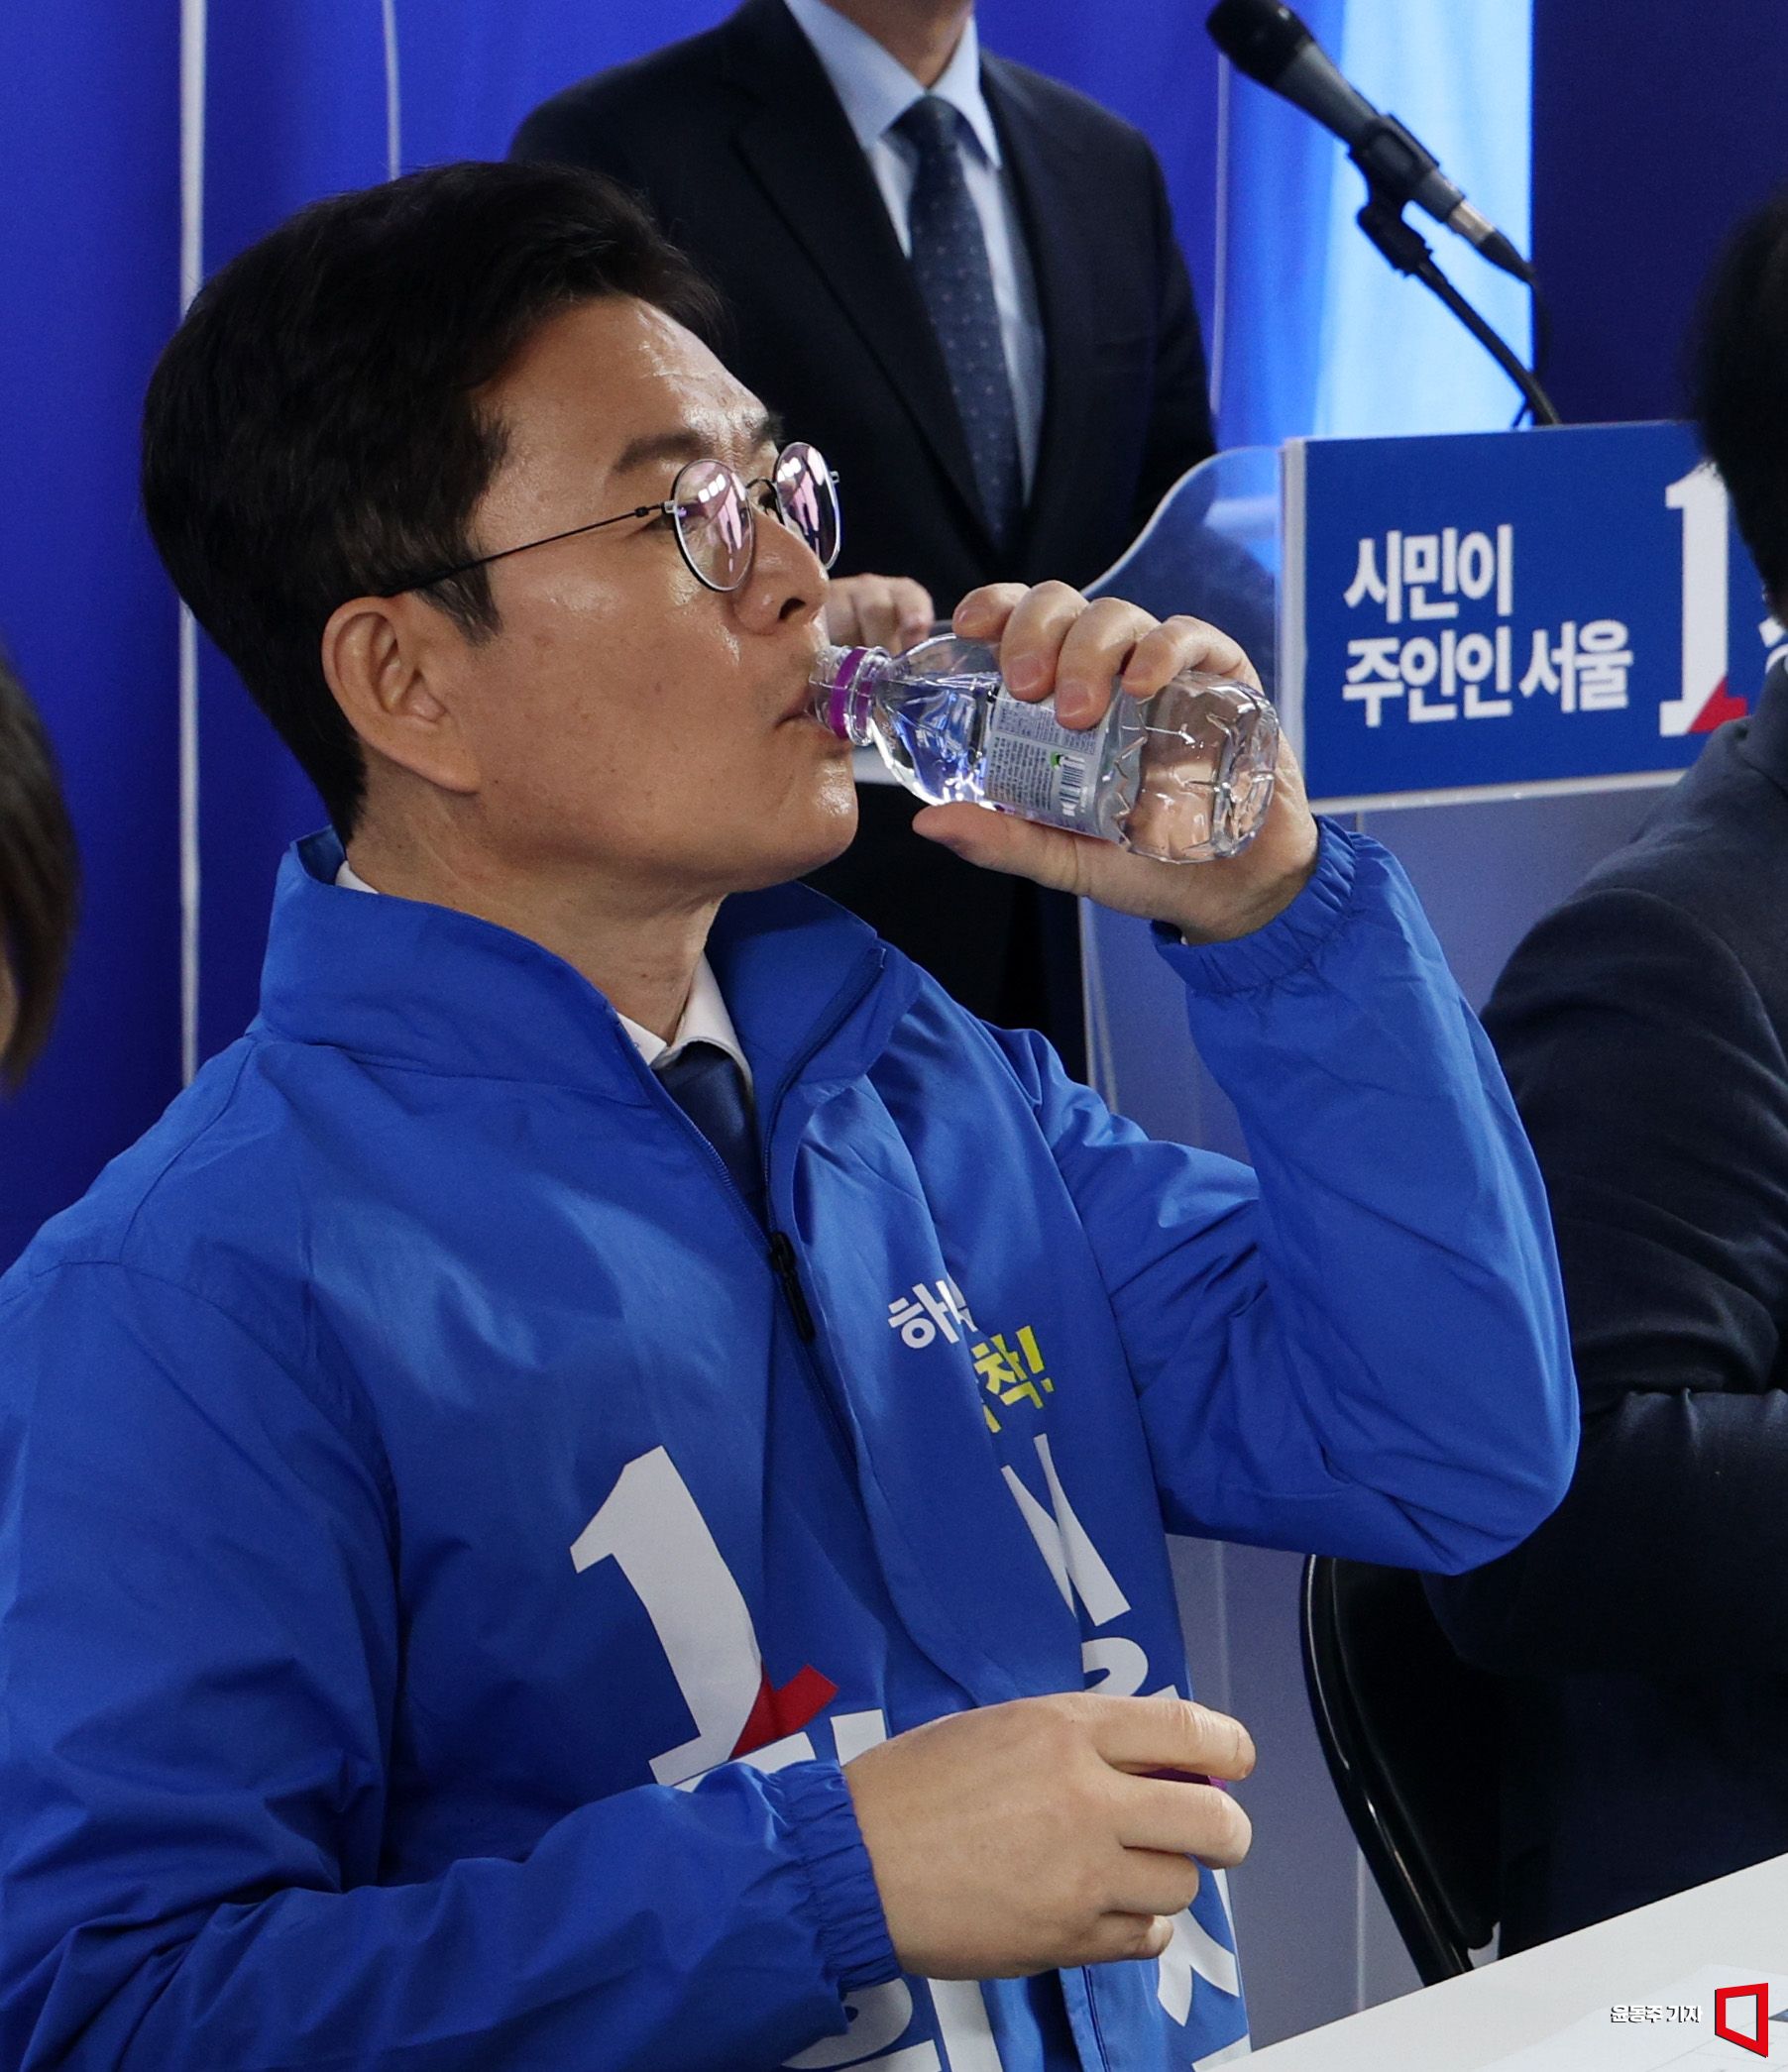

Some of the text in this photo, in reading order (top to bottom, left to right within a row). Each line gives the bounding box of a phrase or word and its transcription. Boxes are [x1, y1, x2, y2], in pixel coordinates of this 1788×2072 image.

[1343, 524, 1513, 624] 시민이
[1659, 461, 1748, 737] 1
[1342, 619, 1633, 728] 주인인 서울
[970, 1325, 1056, 1434] 착!
[569, 1444, 839, 1788] 1
